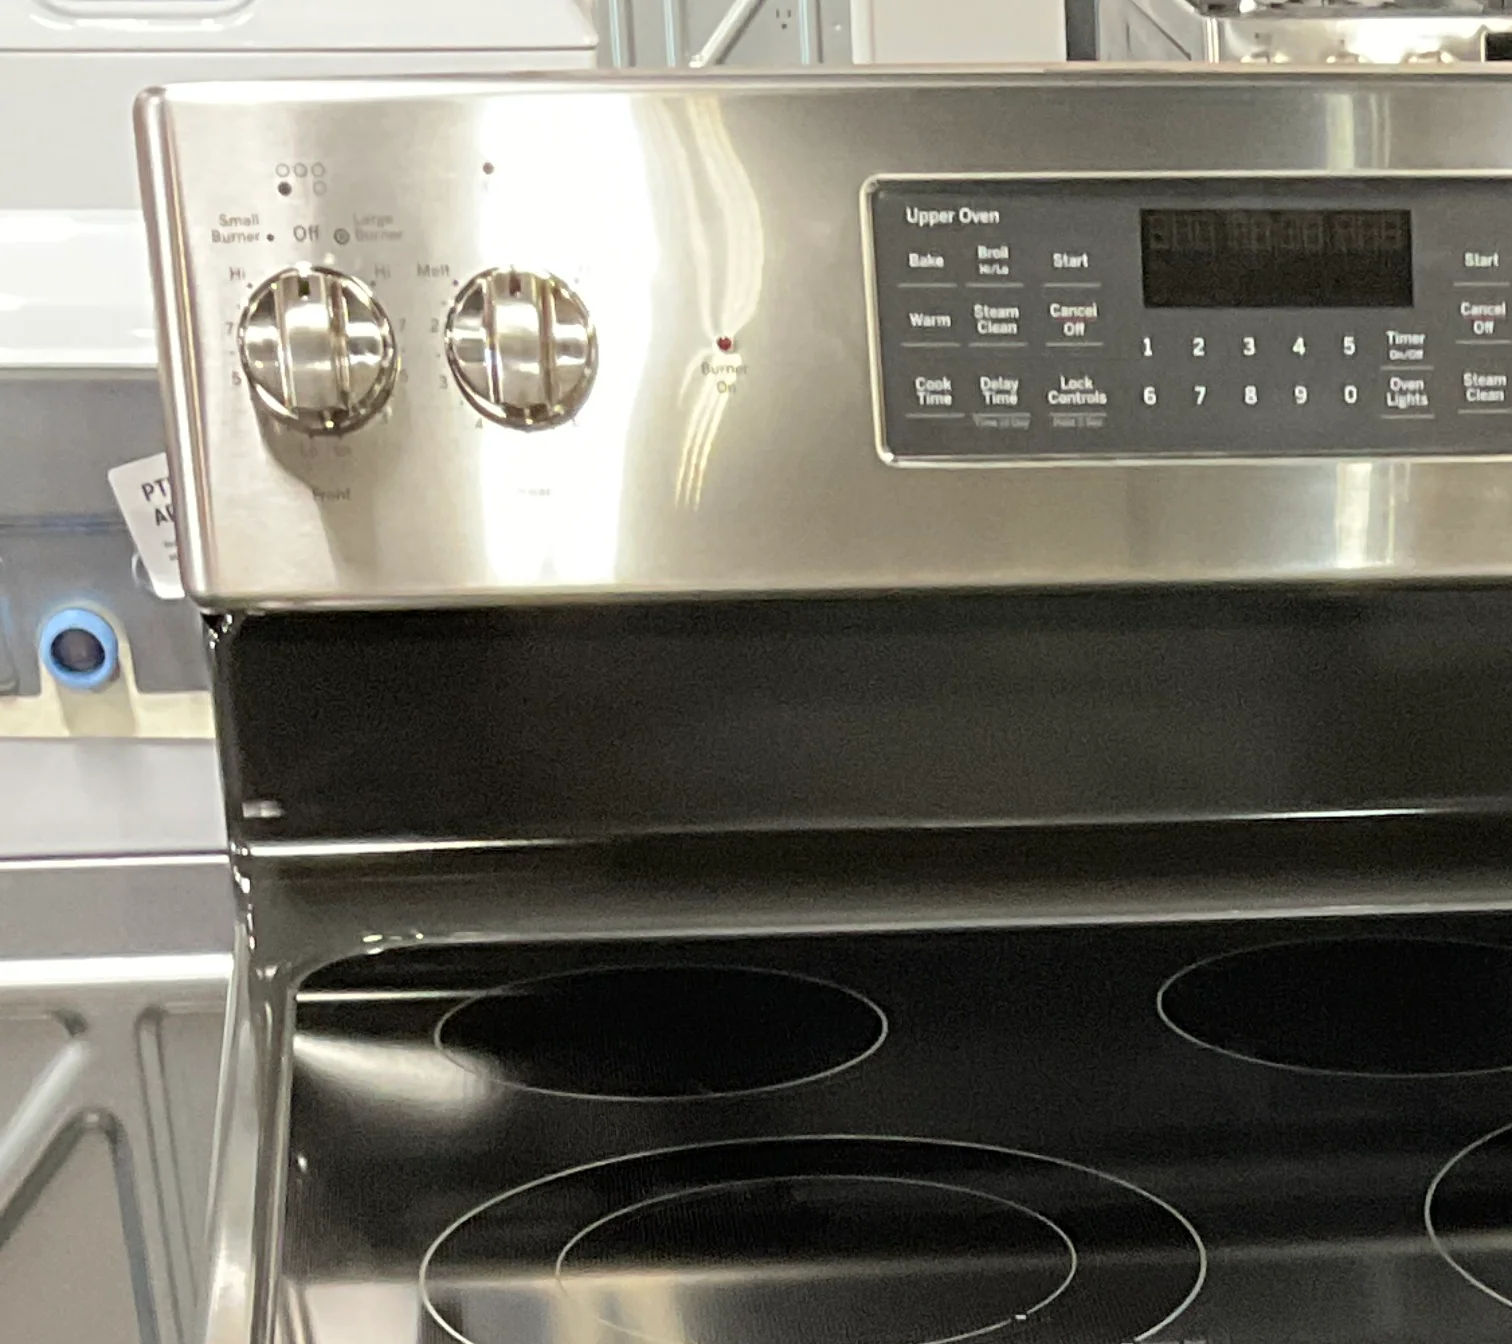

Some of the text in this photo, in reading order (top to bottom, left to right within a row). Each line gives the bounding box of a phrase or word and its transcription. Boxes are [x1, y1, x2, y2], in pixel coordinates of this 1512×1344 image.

[219, 214, 260, 227] Small
[906, 206, 1000, 227] Upper Oven
[211, 230, 260, 244] Burner
[293, 225, 319, 242] Off
[977, 245, 1009, 260] Broil
[1053, 252, 1089, 268] Start
[1464, 251, 1499, 267] Start
[909, 253, 944, 268] Bake
[416, 264, 450, 278] Melt
[973, 304, 1019, 319] Steam
[1050, 302, 1098, 318] Cancel
[1460, 301, 1507, 317] Cancel
[909, 312, 951, 327] Warm
[977, 320, 1018, 334] Clean
[1063, 322, 1085, 336] Off
[1473, 320, 1495, 335] Off
[1386, 330, 1426, 345] Timer
[1143, 336, 1356, 356] 1 2 3 4 5
[915, 376, 952, 391] Cook
[980, 376, 1019, 392] Delay
[1060, 373, 1094, 390] Lock
[1389, 376, 1424, 392] Oven
[1463, 371, 1507, 387] Steam
[916, 391, 953, 406] Time
[982, 391, 1018, 406] Time
[1048, 390, 1108, 405] Controls
[1144, 385, 1357, 405] 6 7 8 9 0
[1387, 392, 1429, 409] Lights
[1466, 387, 1505, 402] Clean
[141, 476, 170, 502] PT
